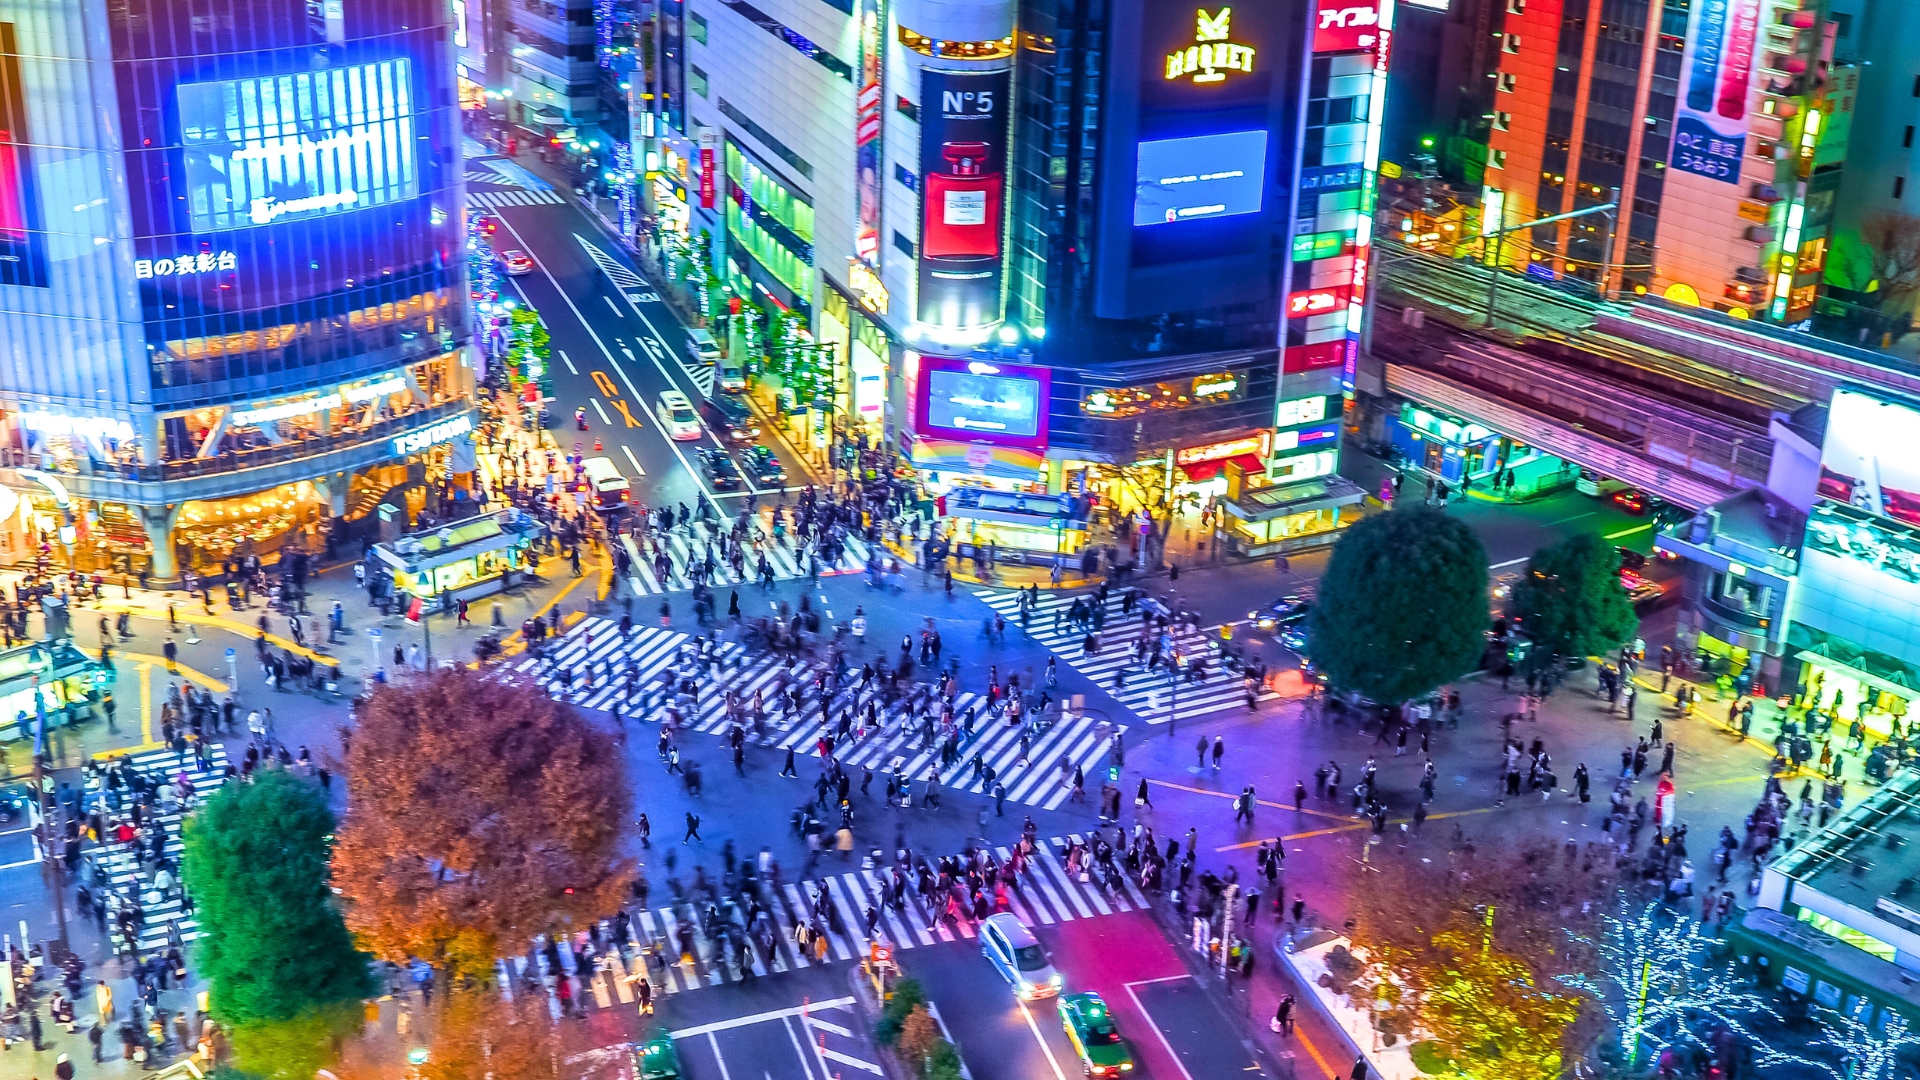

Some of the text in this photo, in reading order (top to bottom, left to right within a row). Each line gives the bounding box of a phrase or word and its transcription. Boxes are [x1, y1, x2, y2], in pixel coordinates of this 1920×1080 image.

[1165, 42, 1255, 83] MAGNET
[1680, 152, 1730, 177] うるおう
[134, 249, 237, 279] 目の表彰台
